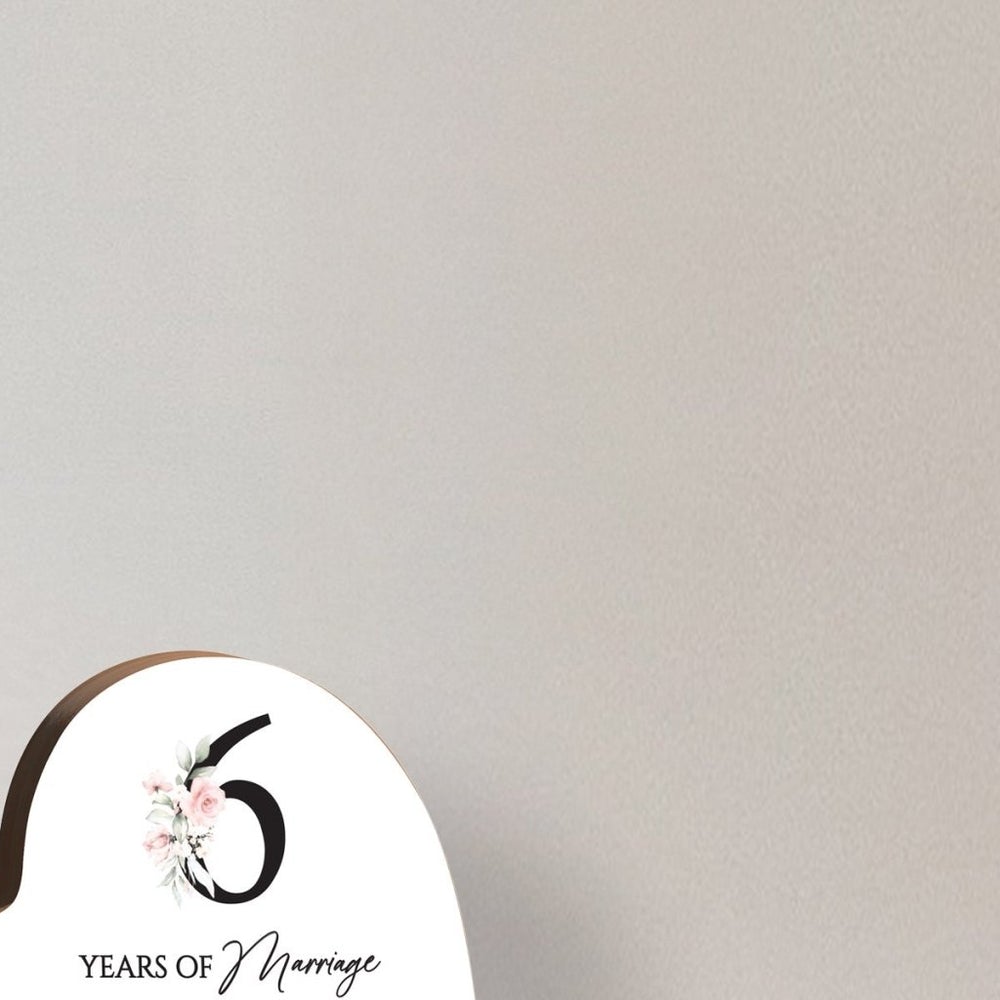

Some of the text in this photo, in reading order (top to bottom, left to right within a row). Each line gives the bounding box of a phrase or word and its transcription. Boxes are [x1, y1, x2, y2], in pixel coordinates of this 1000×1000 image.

[180, 713, 286, 905] 6
[78, 930, 382, 998] YEARS OF Marriage
